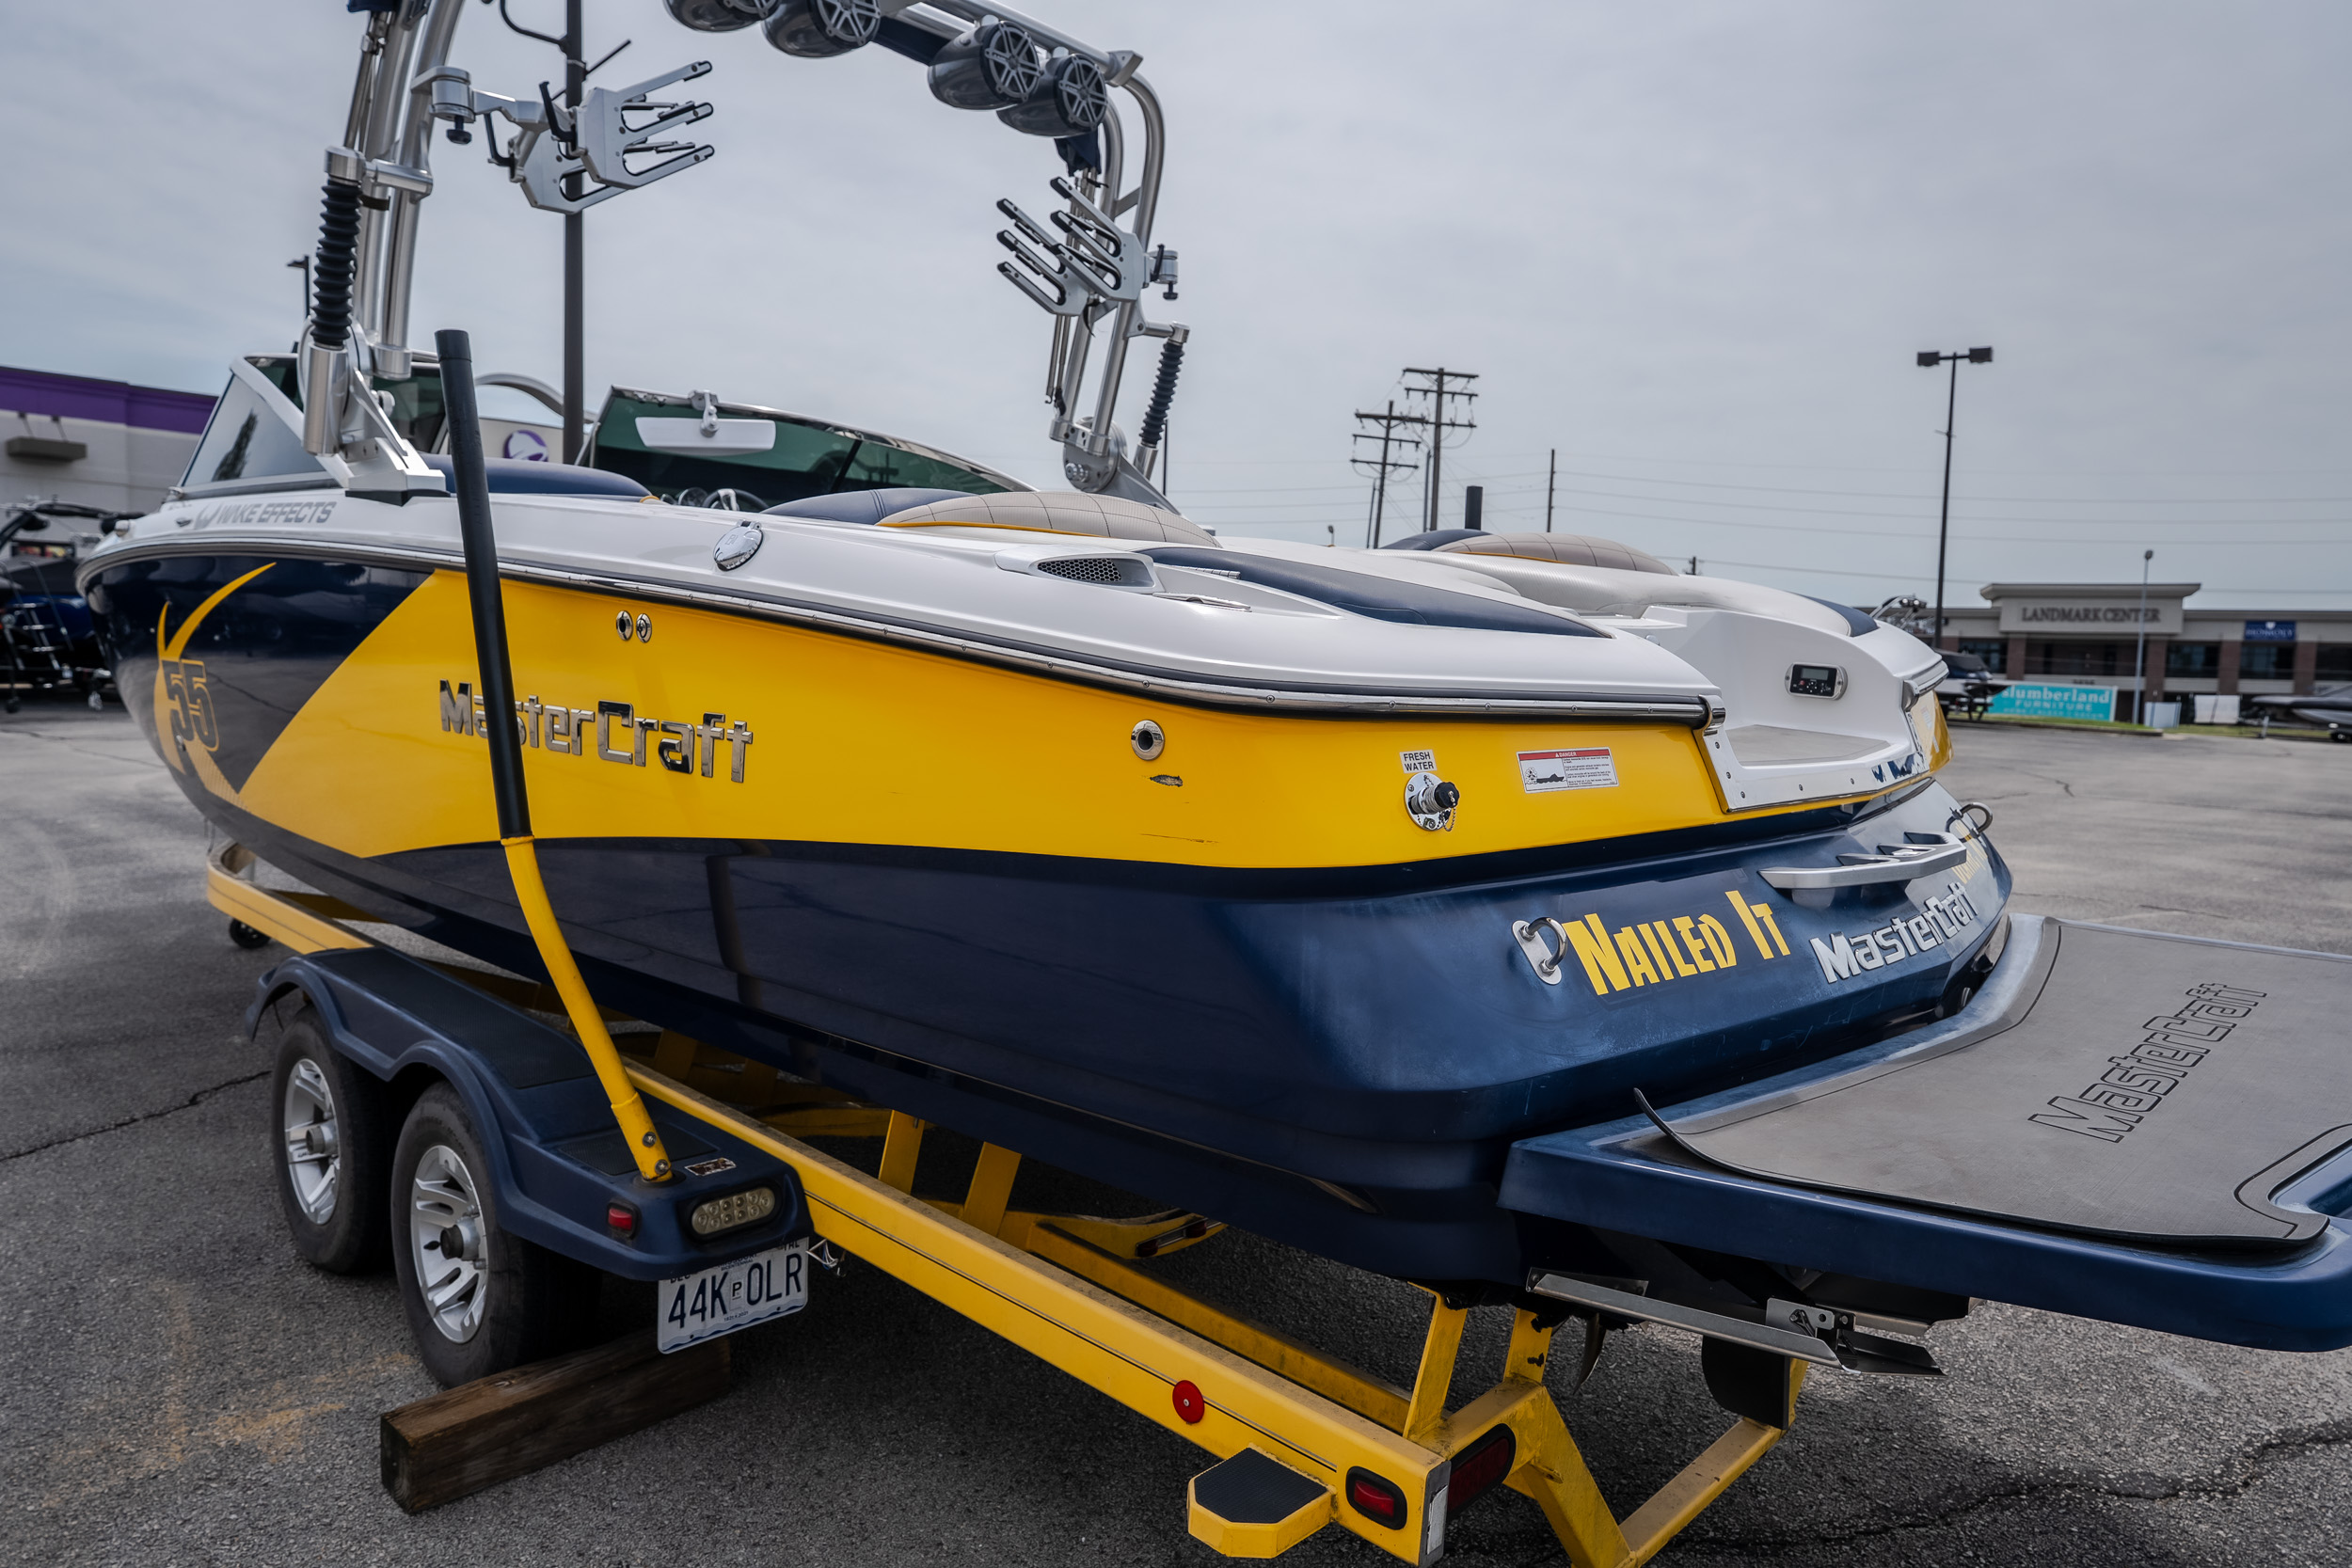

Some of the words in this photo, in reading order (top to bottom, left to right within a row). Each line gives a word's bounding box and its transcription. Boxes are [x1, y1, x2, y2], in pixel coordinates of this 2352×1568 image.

[257, 501, 337, 524] EFFECTS
[2021, 607, 2101, 623] LANDMARK
[2103, 607, 2161, 623] CENTER
[2002, 686, 2110, 704] slumberland
[2015, 701, 2093, 711] FURNITURE
[1403, 752, 1431, 761] FRESH
[1405, 761, 1434, 771] WATER
[1809, 882, 1979, 984] MasterCraft
[2027, 983, 2267, 1143] MasterCraft
[668, 1272, 729, 1329] 44K
